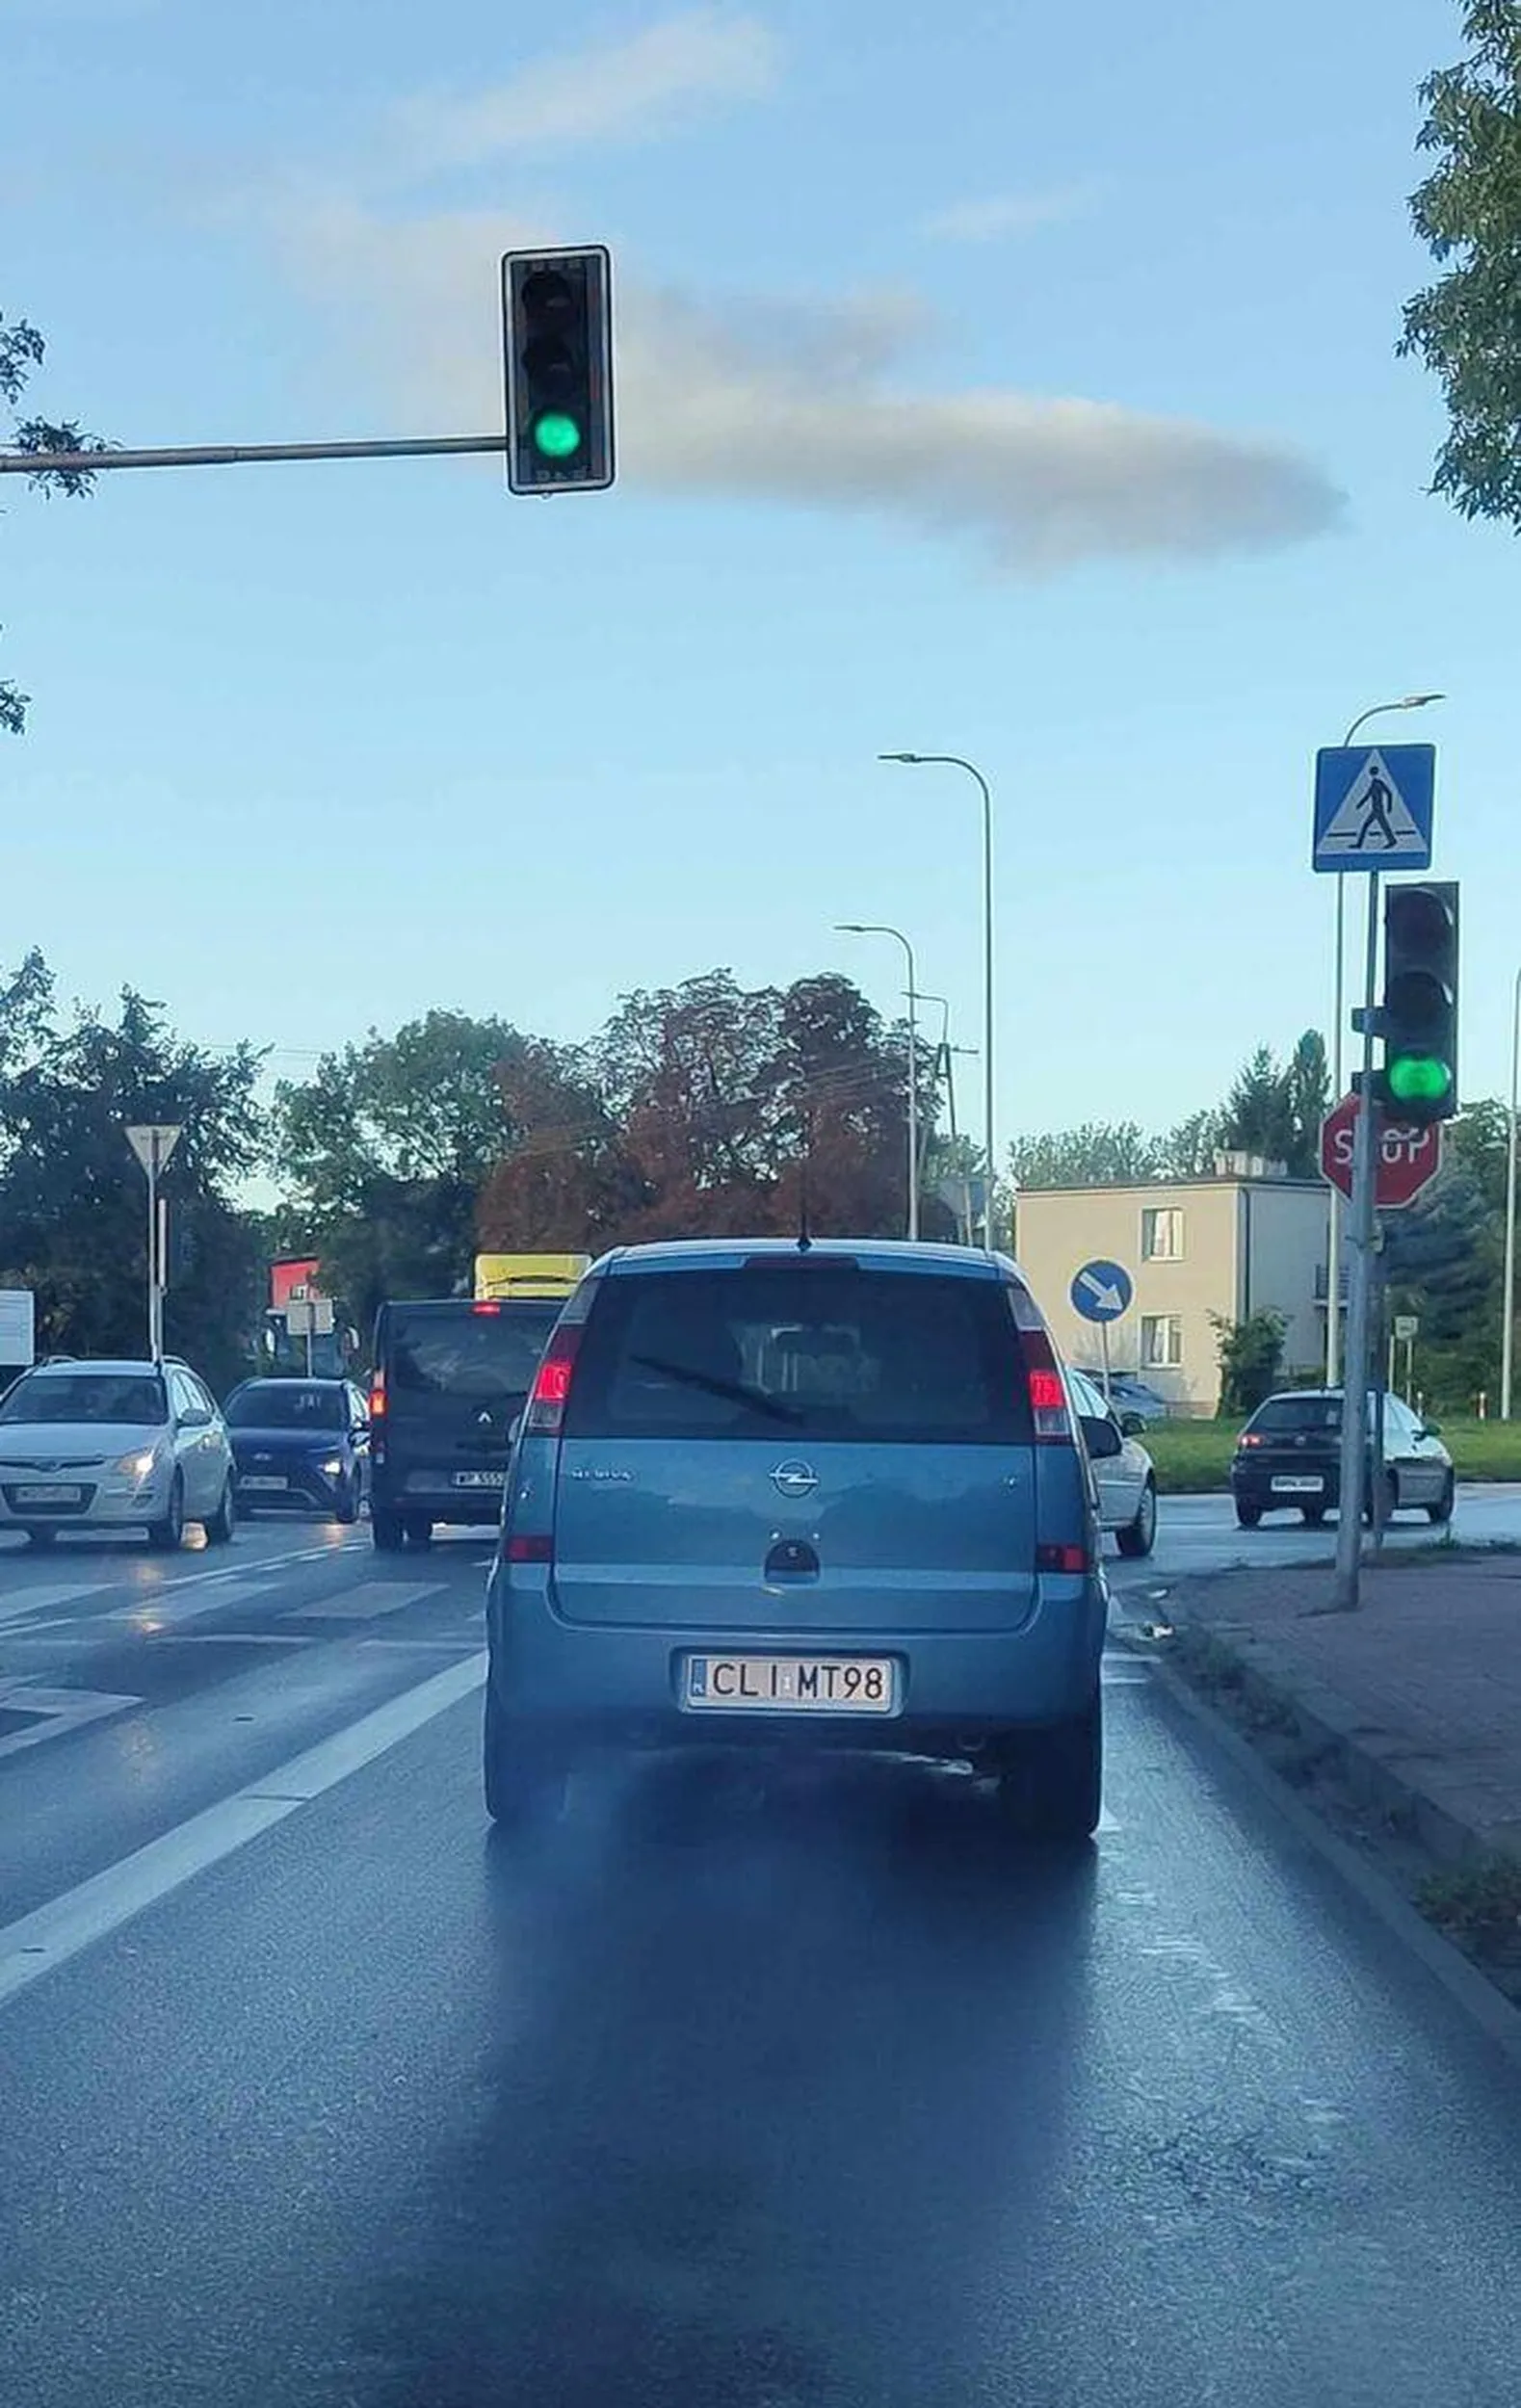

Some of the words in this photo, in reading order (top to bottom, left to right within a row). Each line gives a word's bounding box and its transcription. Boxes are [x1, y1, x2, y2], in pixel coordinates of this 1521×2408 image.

[1334, 1127, 1430, 1165] SOP
[712, 1662, 778, 1697] CLI
[798, 1663, 884, 1700] MT98
